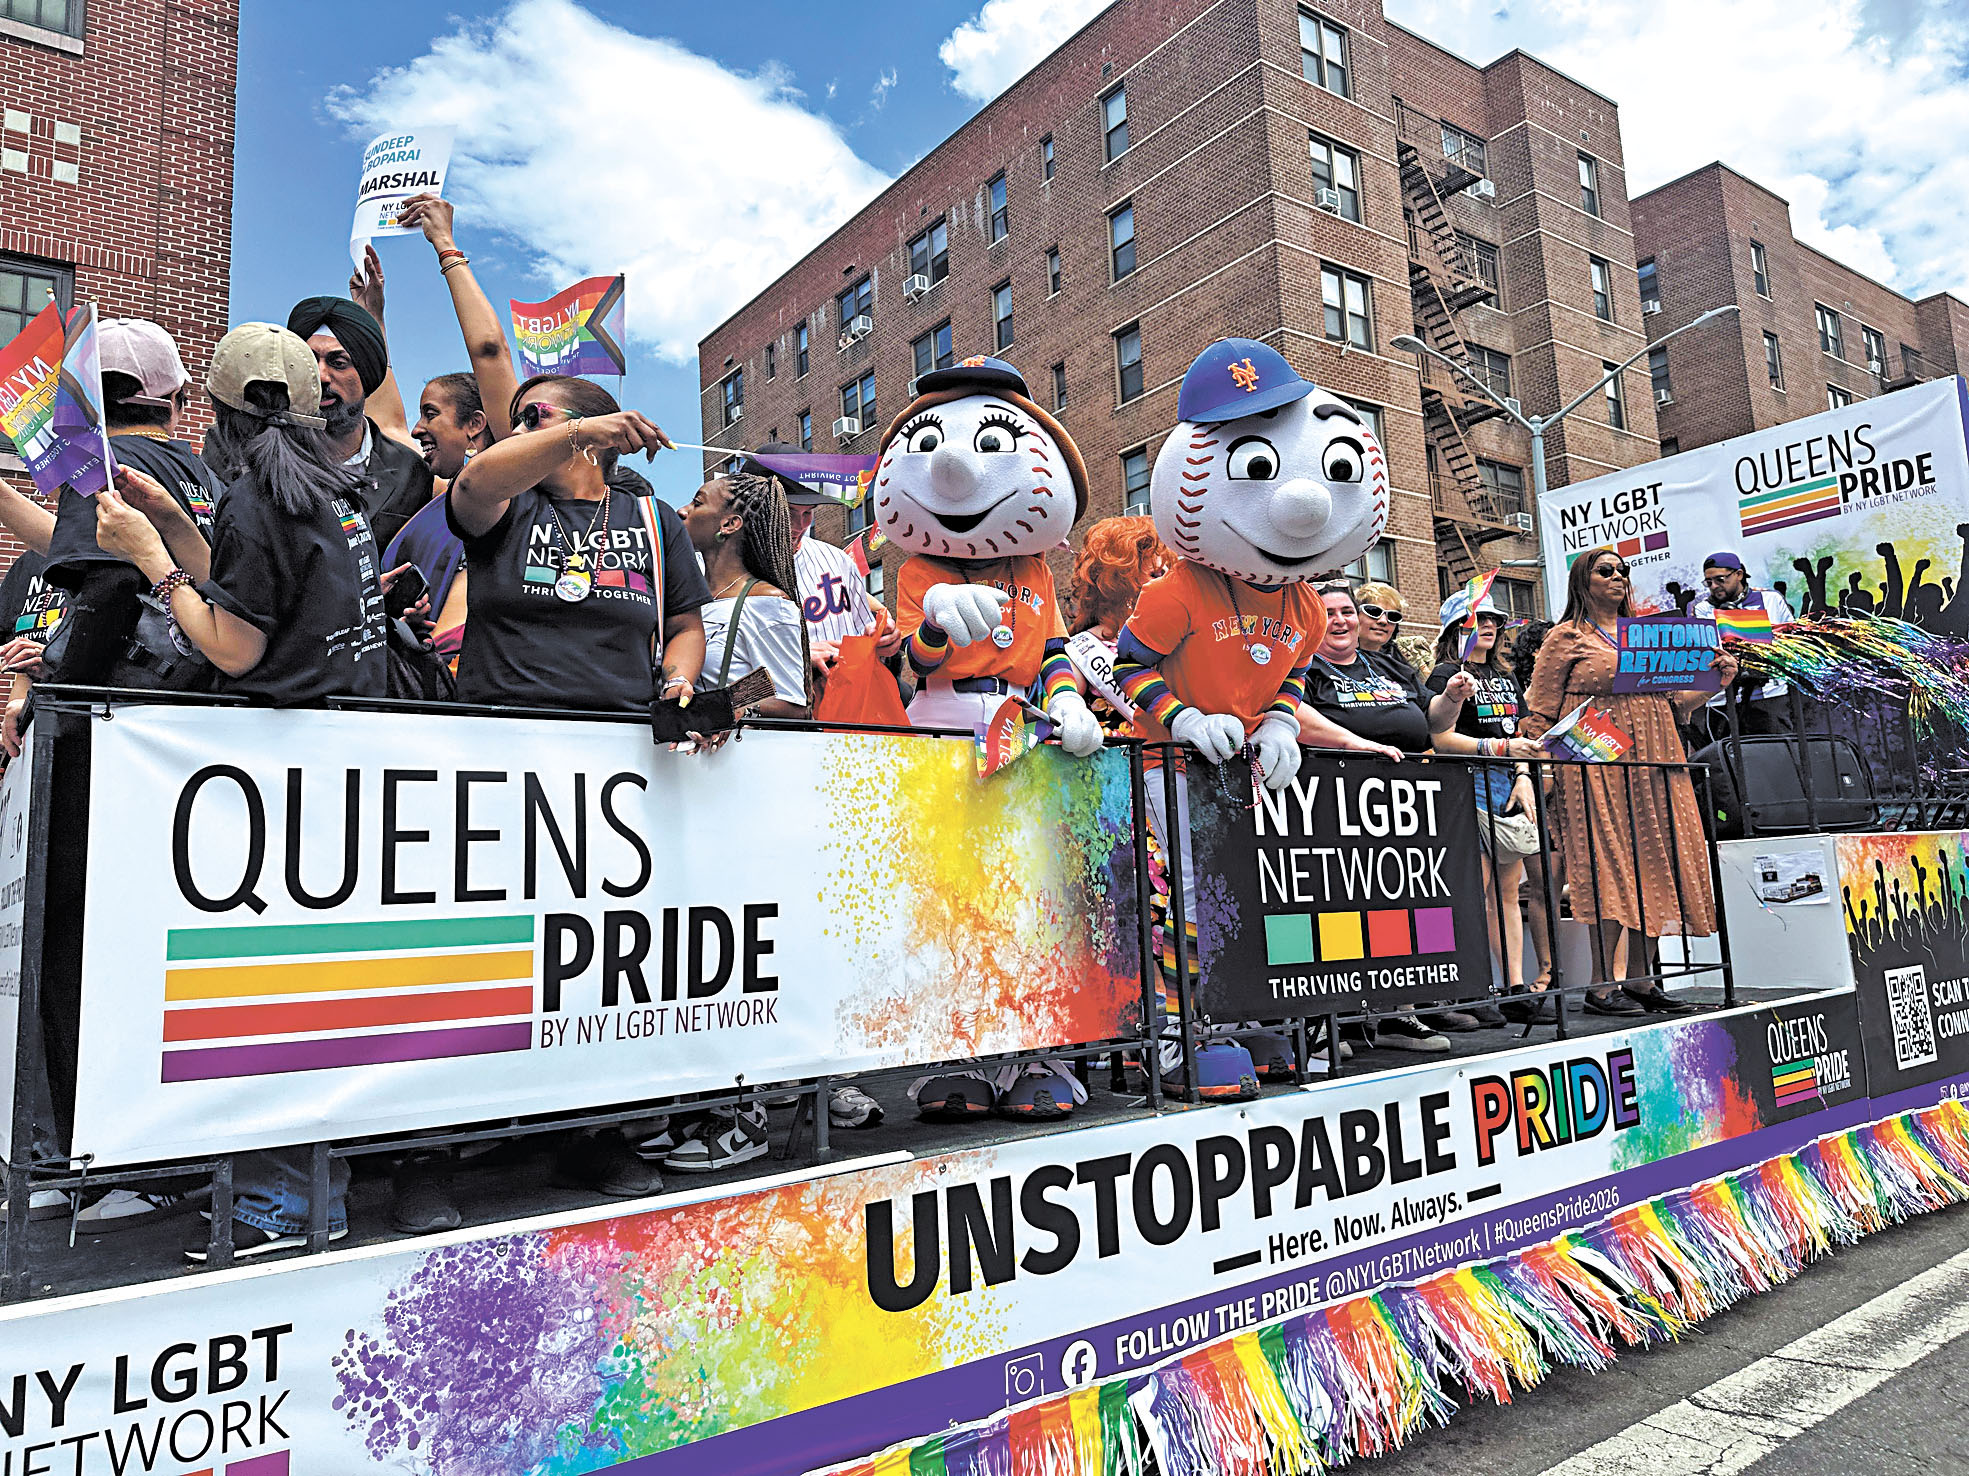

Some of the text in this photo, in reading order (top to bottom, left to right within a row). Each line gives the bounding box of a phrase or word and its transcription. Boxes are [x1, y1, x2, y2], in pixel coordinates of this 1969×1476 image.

[360, 171, 440, 196] MARSHAL
[1734, 423, 1877, 496] QUEENS
[1839, 452, 1936, 504] PRIDE
[1560, 481, 1663, 530] NY LGBT
[1843, 484, 1938, 515] BY NY LGBT NETWORK
[572, 527, 647, 552] LGBT
[1562, 507, 1668, 552] NETWORK
[526, 546, 650, 573] NEWORK
[1624, 551, 1672, 568] OGETHER
[593, 589, 652, 606] TOGETHER
[803, 572, 852, 624] ets
[1211, 614, 1259, 642] NEW
[1652, 674, 1695, 685] CONGRESS
[1251, 775, 1442, 838] NY LGBT
[171, 763, 652, 916] QUEENS
[1257, 846, 1452, 904] NETWORK
[542, 902, 780, 1013] PRIDE
[1268, 963, 1460, 999] THRIVING TOGETHER
[1932, 978, 1963, 1008] SCAN
[540, 997, 779, 1049] BY NY LGBT NETWORK
[1767, 1013, 1829, 1064] QUEENS
[1813, 1049, 1850, 1086] PRIDE
[865, 1047, 1641, 1313] UNSTOPPABLE PRIDE
[1268, 1191, 1463, 1265] Here. Now. Always.
[1116, 1310, 1210, 1366] FOLLOW
[1214, 1296, 1258, 1333] THE
[1261, 1276, 1321, 1321] PRIDE
[1325, 1228, 1482, 1300] @NYLGBTNetwork
[1494, 1185, 1621, 1245] #QueensPride2026
[0, 1322, 293, 1438] NY LGBT
